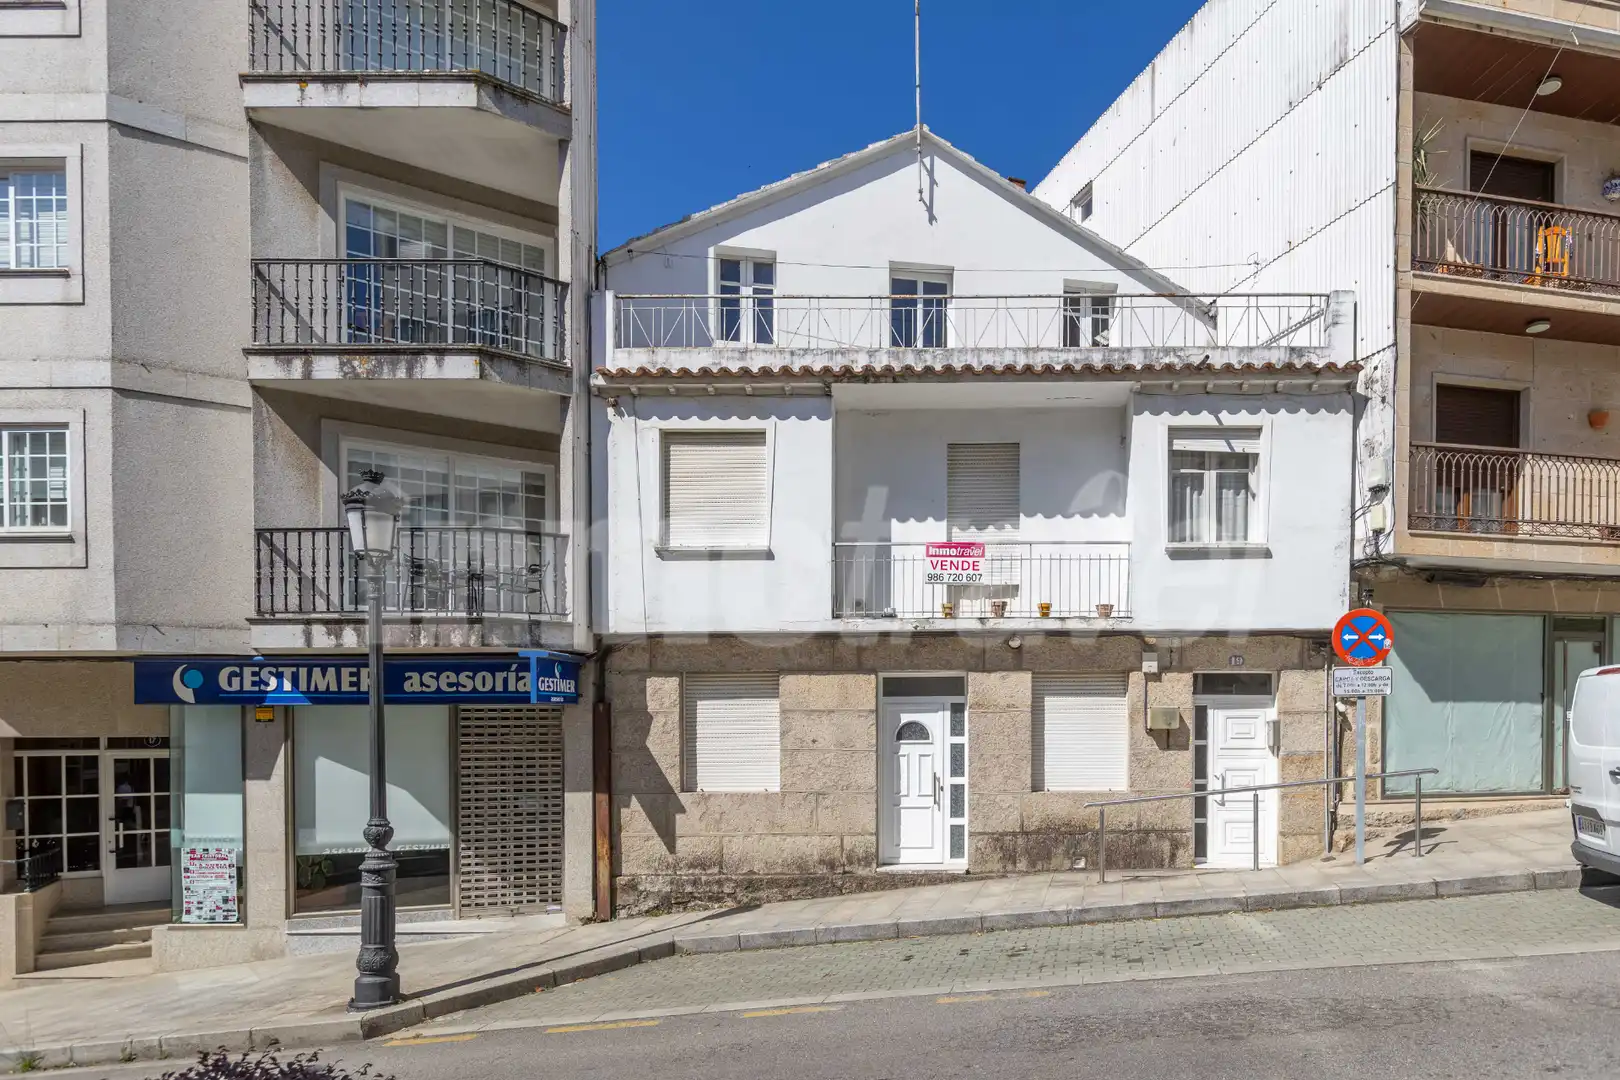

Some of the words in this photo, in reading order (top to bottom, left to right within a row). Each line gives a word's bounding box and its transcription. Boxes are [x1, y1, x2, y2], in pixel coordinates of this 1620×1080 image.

[929, 546, 983, 556] Inmotravel
[930, 560, 980, 571] VENDE
[927, 573, 944, 582] 986
[947, 573, 963, 582] 720
[966, 573, 983, 582] 607
[1231, 656, 1243, 665] 19
[403, 664, 531, 692] asesoría
[538, 677, 575, 692] GESTIMER
